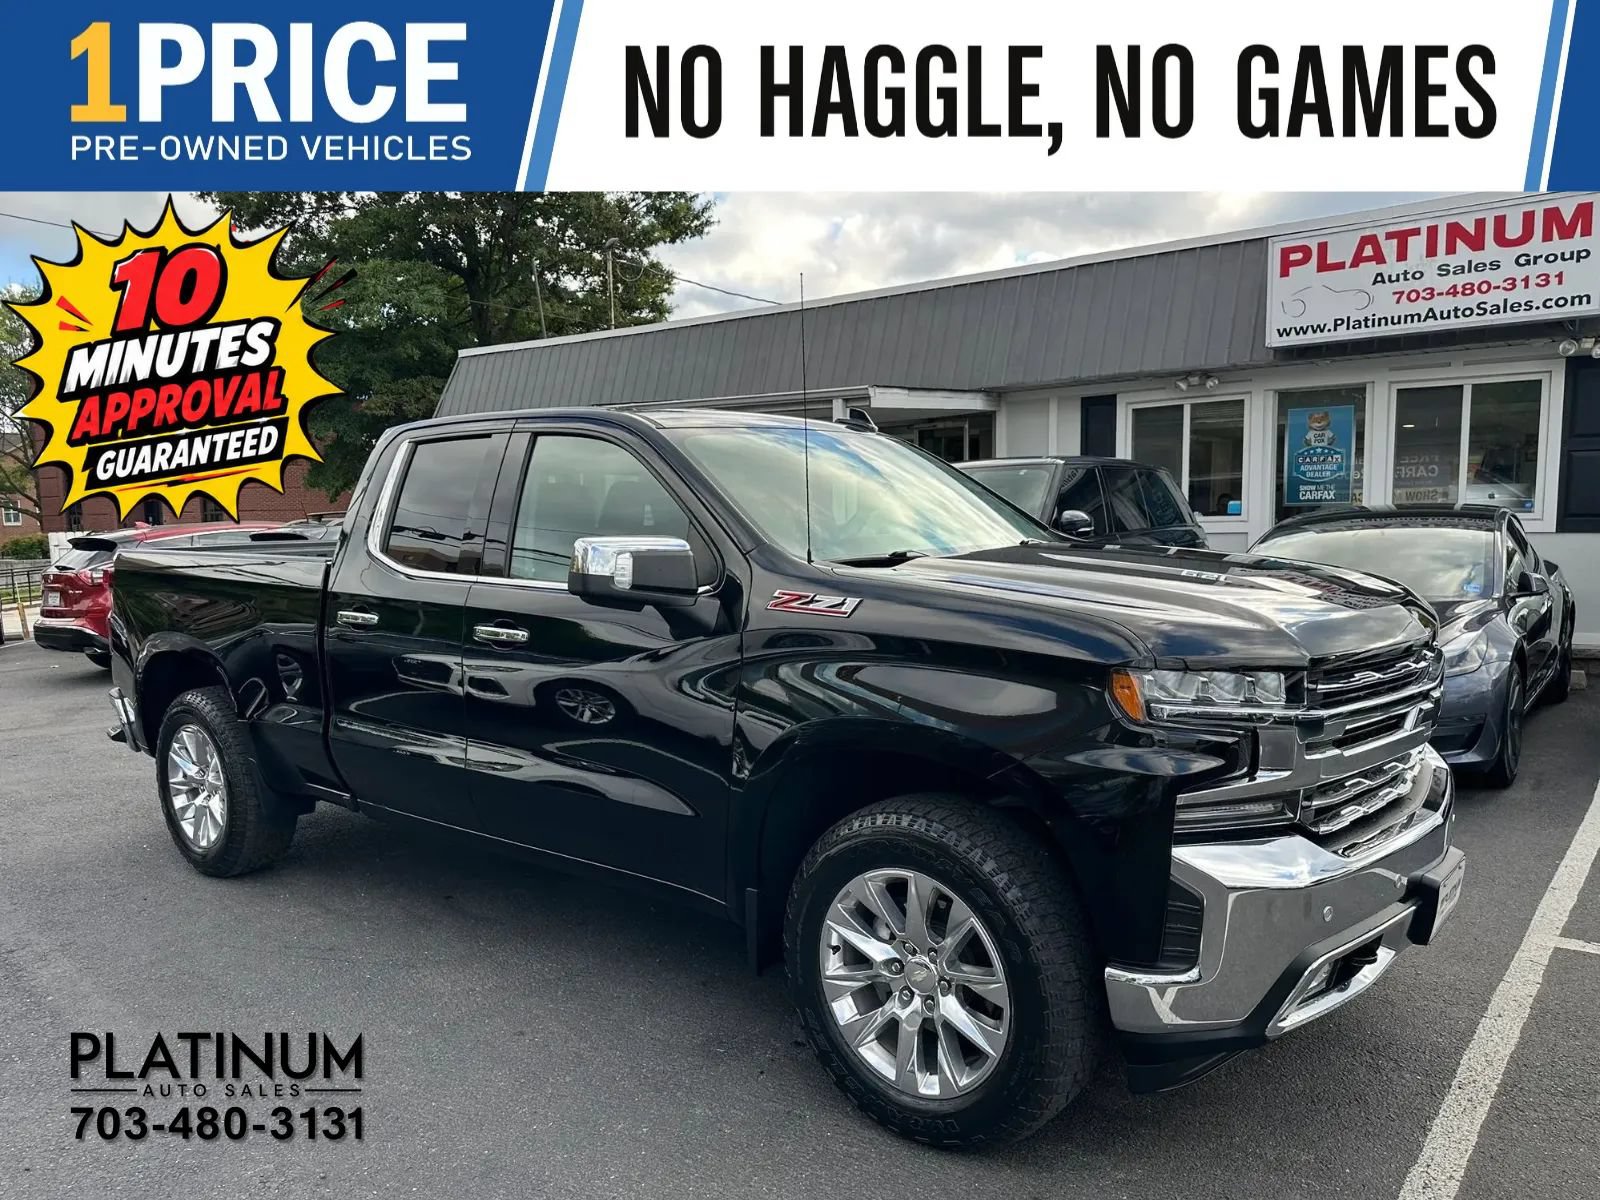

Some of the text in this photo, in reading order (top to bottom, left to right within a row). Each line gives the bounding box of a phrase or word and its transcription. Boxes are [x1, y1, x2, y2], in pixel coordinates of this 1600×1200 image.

[1279, 201, 1594, 278] PLATINUM
[1372, 248, 1592, 286] Auto Sales Group
[1392, 271, 1565, 305] 703-480-3131
[1276, 292, 1592, 338] www.PlatinumAutoSales.com
[1298, 455, 1341, 463] CARFAX
[1299, 490, 1336, 500] CARFAX
[766, 588, 864, 618] Z71
